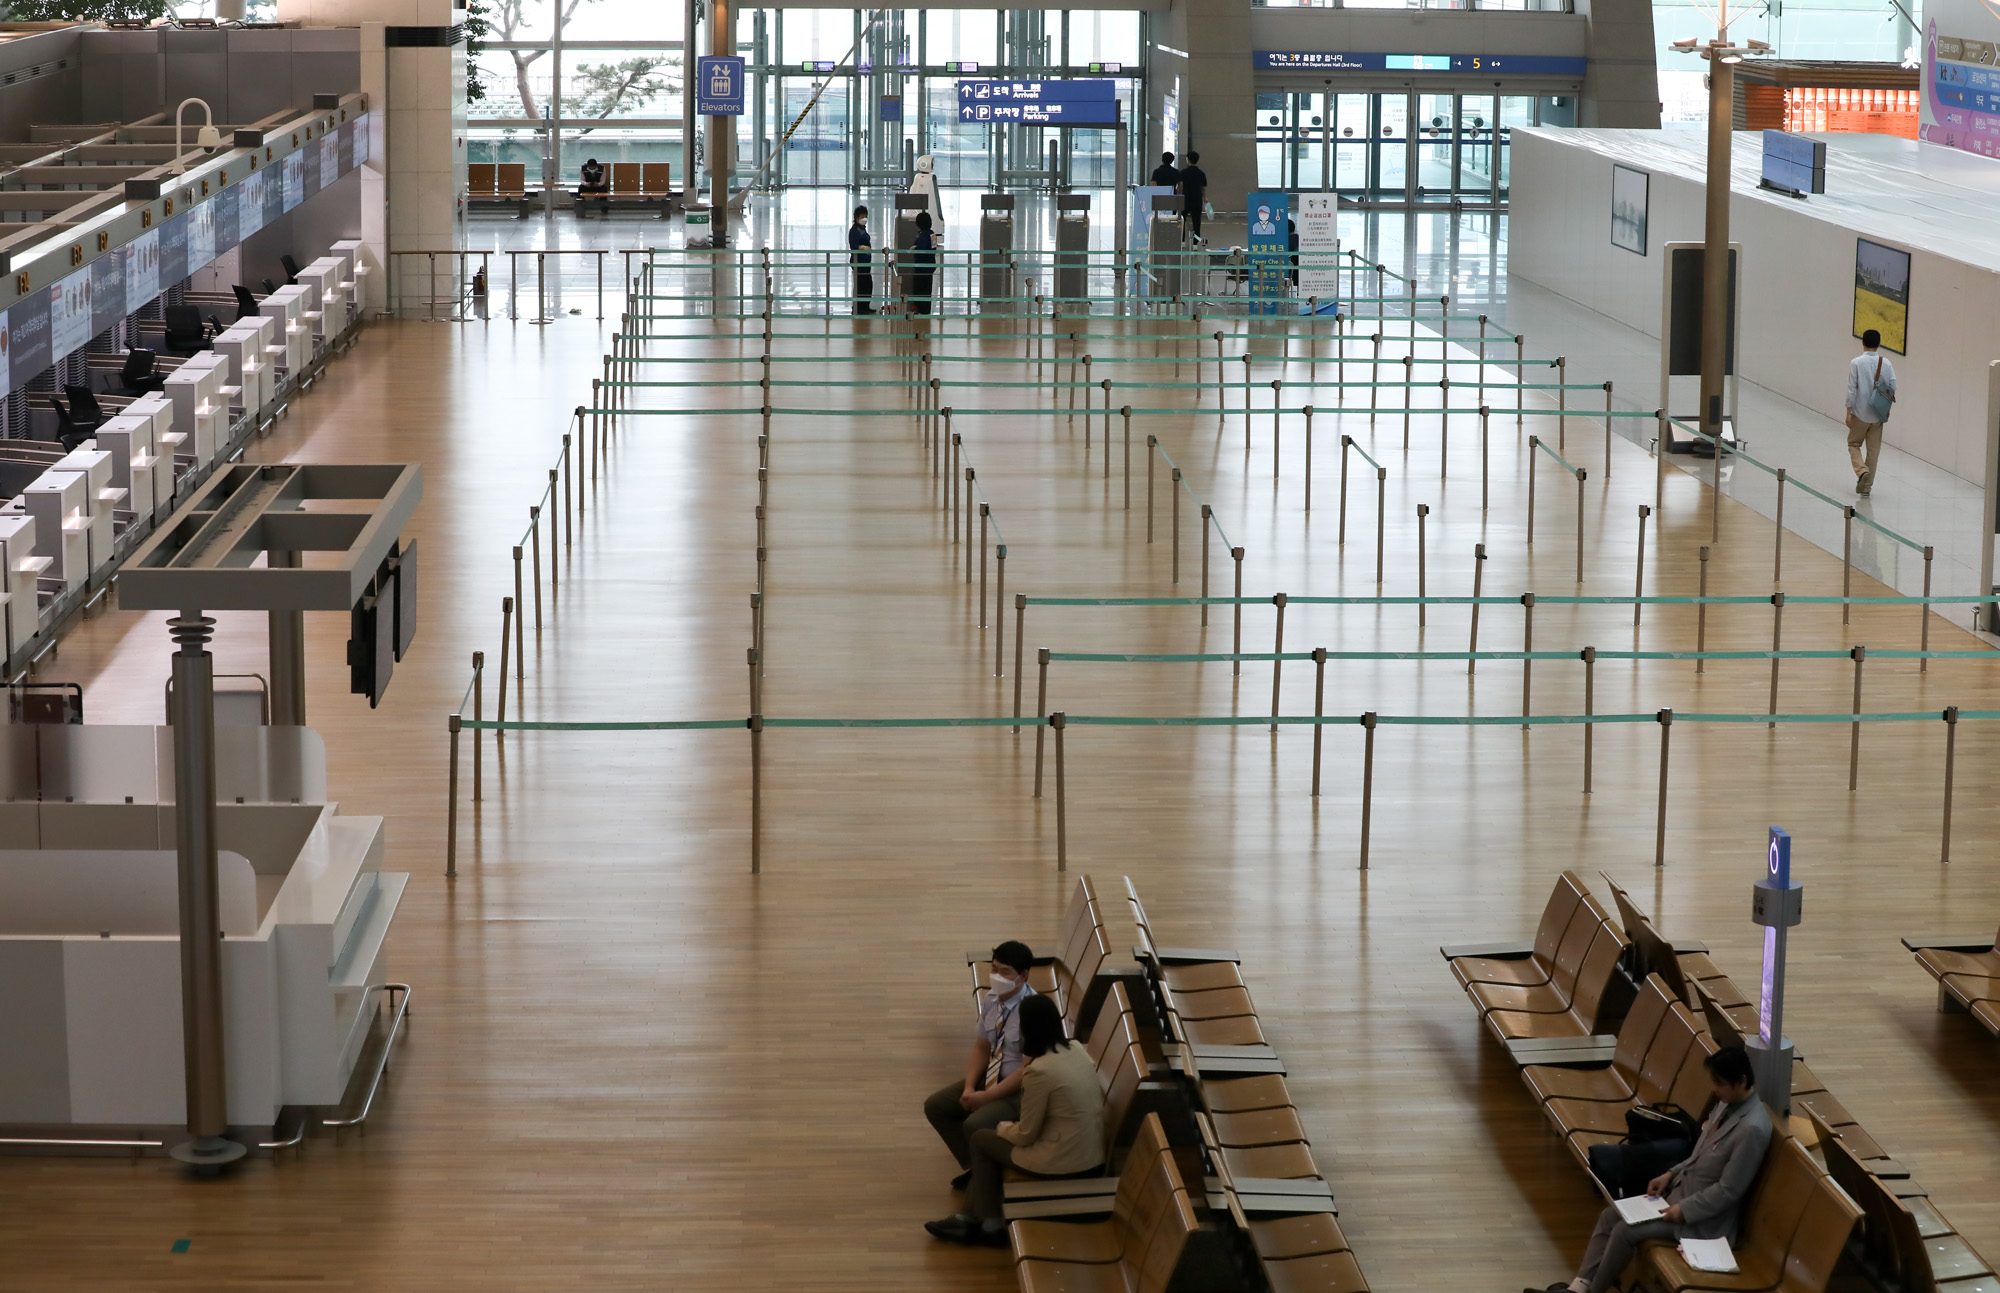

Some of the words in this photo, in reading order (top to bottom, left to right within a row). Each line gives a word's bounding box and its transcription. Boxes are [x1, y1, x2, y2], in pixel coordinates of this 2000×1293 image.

[1269, 54, 1288, 62] 여기는
[1290, 54, 1301, 62] 3층
[1303, 54, 1322, 62] 출발층
[1324, 54, 1343, 62] 입니다
[1473, 58, 1481, 69] 5
[993, 86, 1009, 96] 도착
[1013, 91, 1039, 99] Arrivals
[701, 102, 741, 112] Elevators
[994, 107, 1020, 118] 주차장
[1023, 112, 1049, 122] Parking
[1252, 244, 1285, 252] 발열체크
